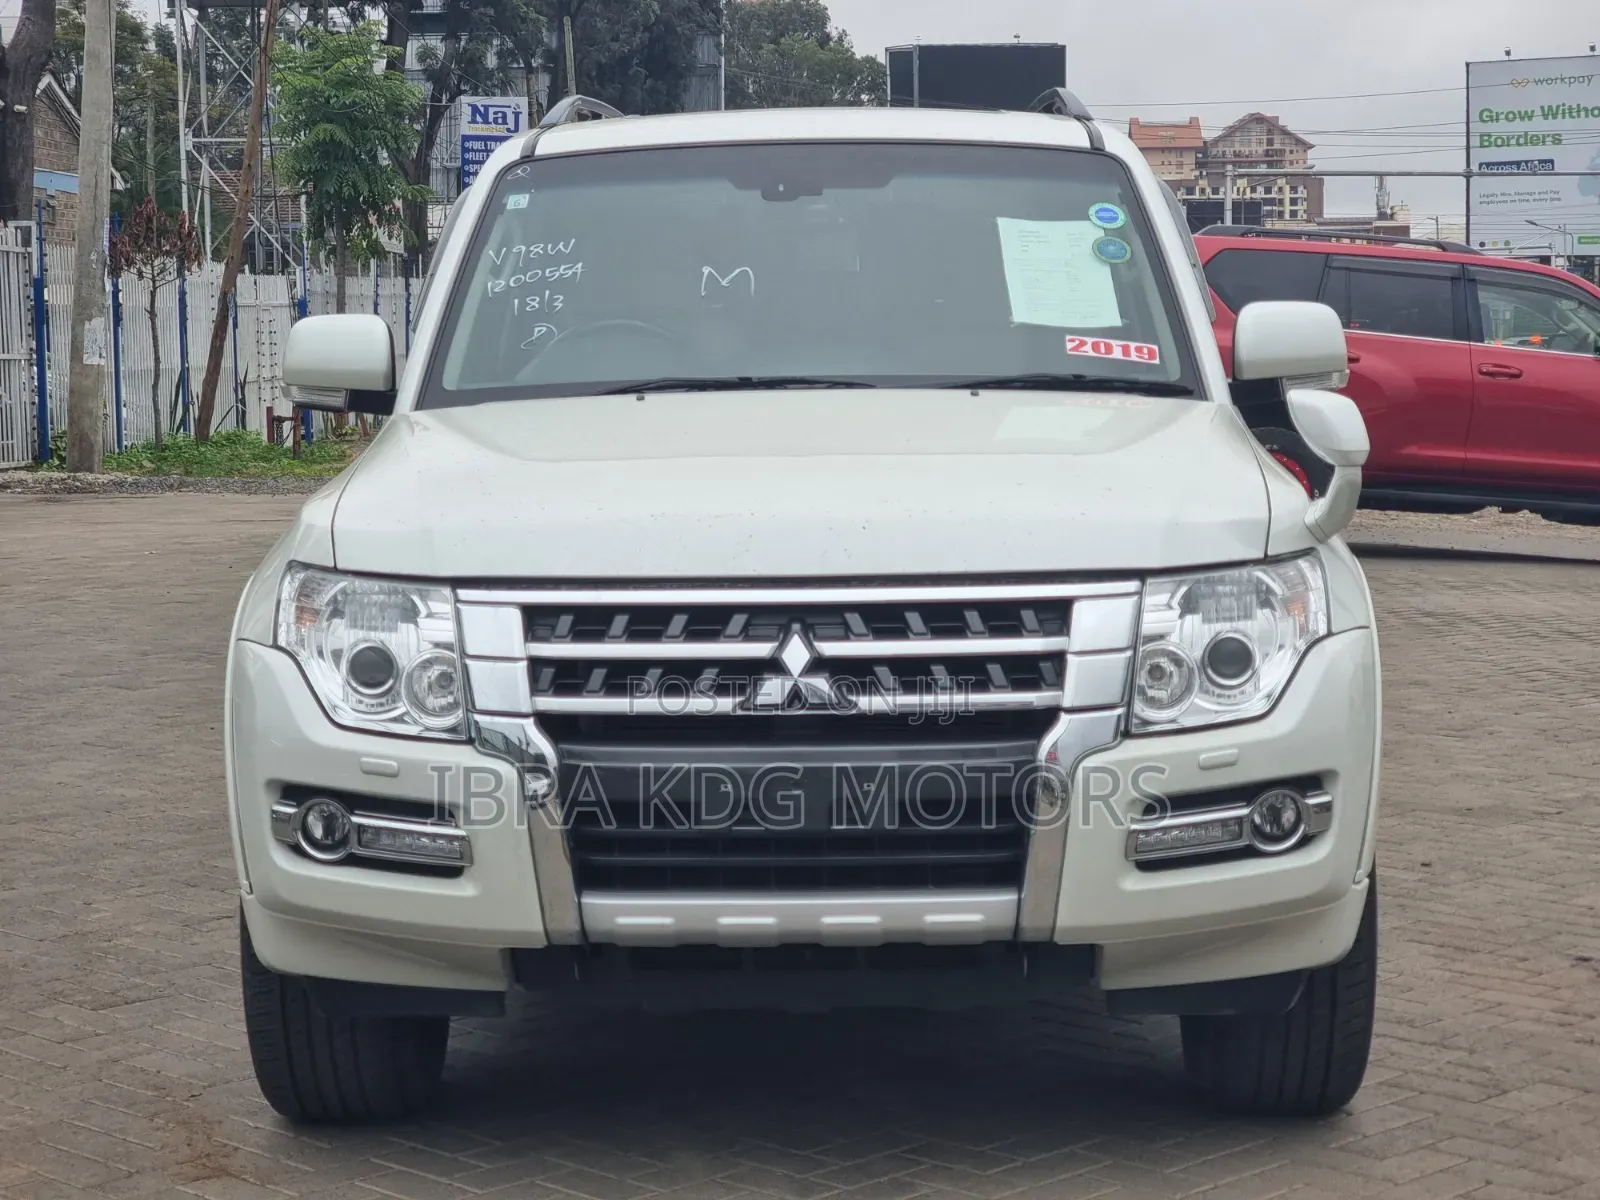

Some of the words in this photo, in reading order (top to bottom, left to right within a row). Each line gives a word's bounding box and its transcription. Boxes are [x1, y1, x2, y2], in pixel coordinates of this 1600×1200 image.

[1533, 73, 1594, 88] workpay
[467, 103, 522, 133] Naj
[1479, 107, 1535, 123] Grow
[1540, 102, 1600, 120] Witho
[469, 141, 486, 150] FUEL
[1479, 131, 1563, 148] Borders
[469, 152, 487, 161] FLEET
[1481, 164, 1518, 172] Across
[1067, 337, 1158, 362] 2019
